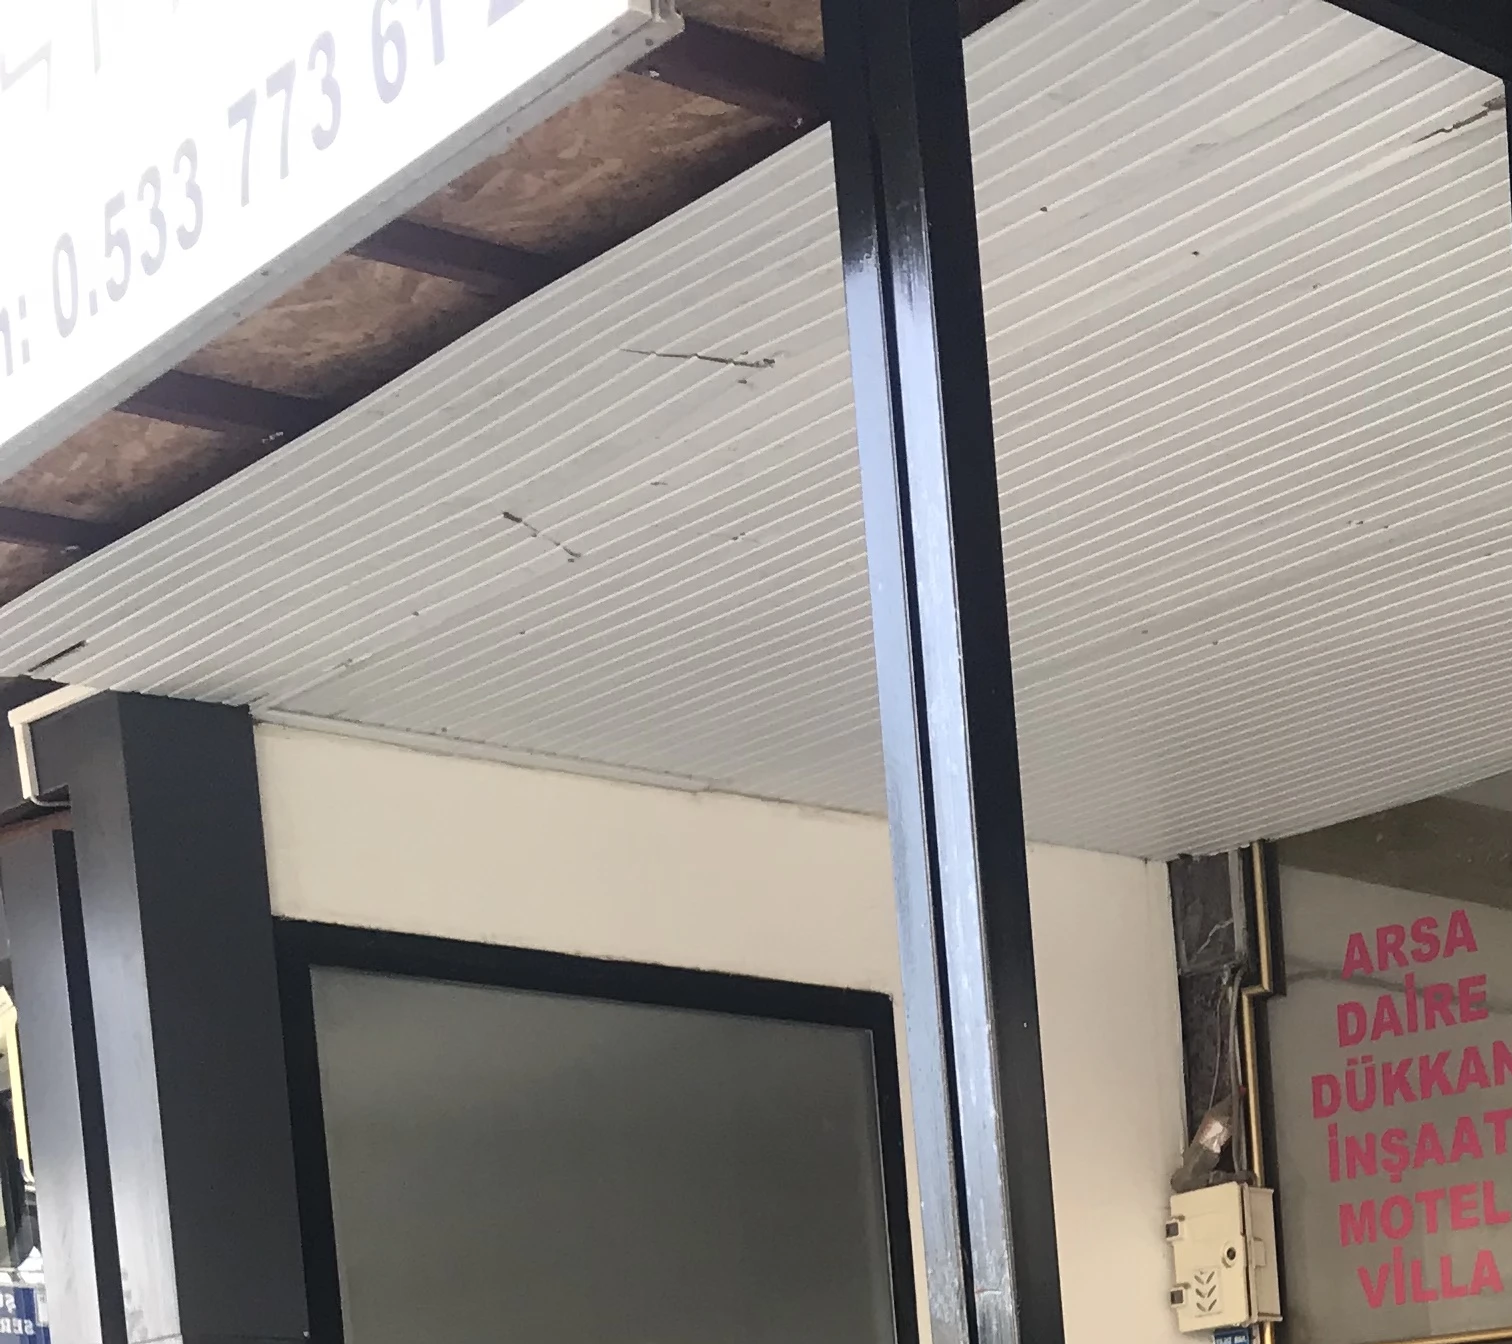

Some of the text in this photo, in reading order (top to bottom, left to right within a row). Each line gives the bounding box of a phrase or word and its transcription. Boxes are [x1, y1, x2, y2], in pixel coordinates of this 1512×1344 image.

[51, 137, 204, 339] 0.533
[226, 29, 342, 207] 773
[1342, 909, 1479, 981] ARSA
[1336, 974, 1489, 1048] DAİRE
[1338, 1180, 1512, 1248] MOTEL
[1357, 1246, 1505, 1310] VİLLA
